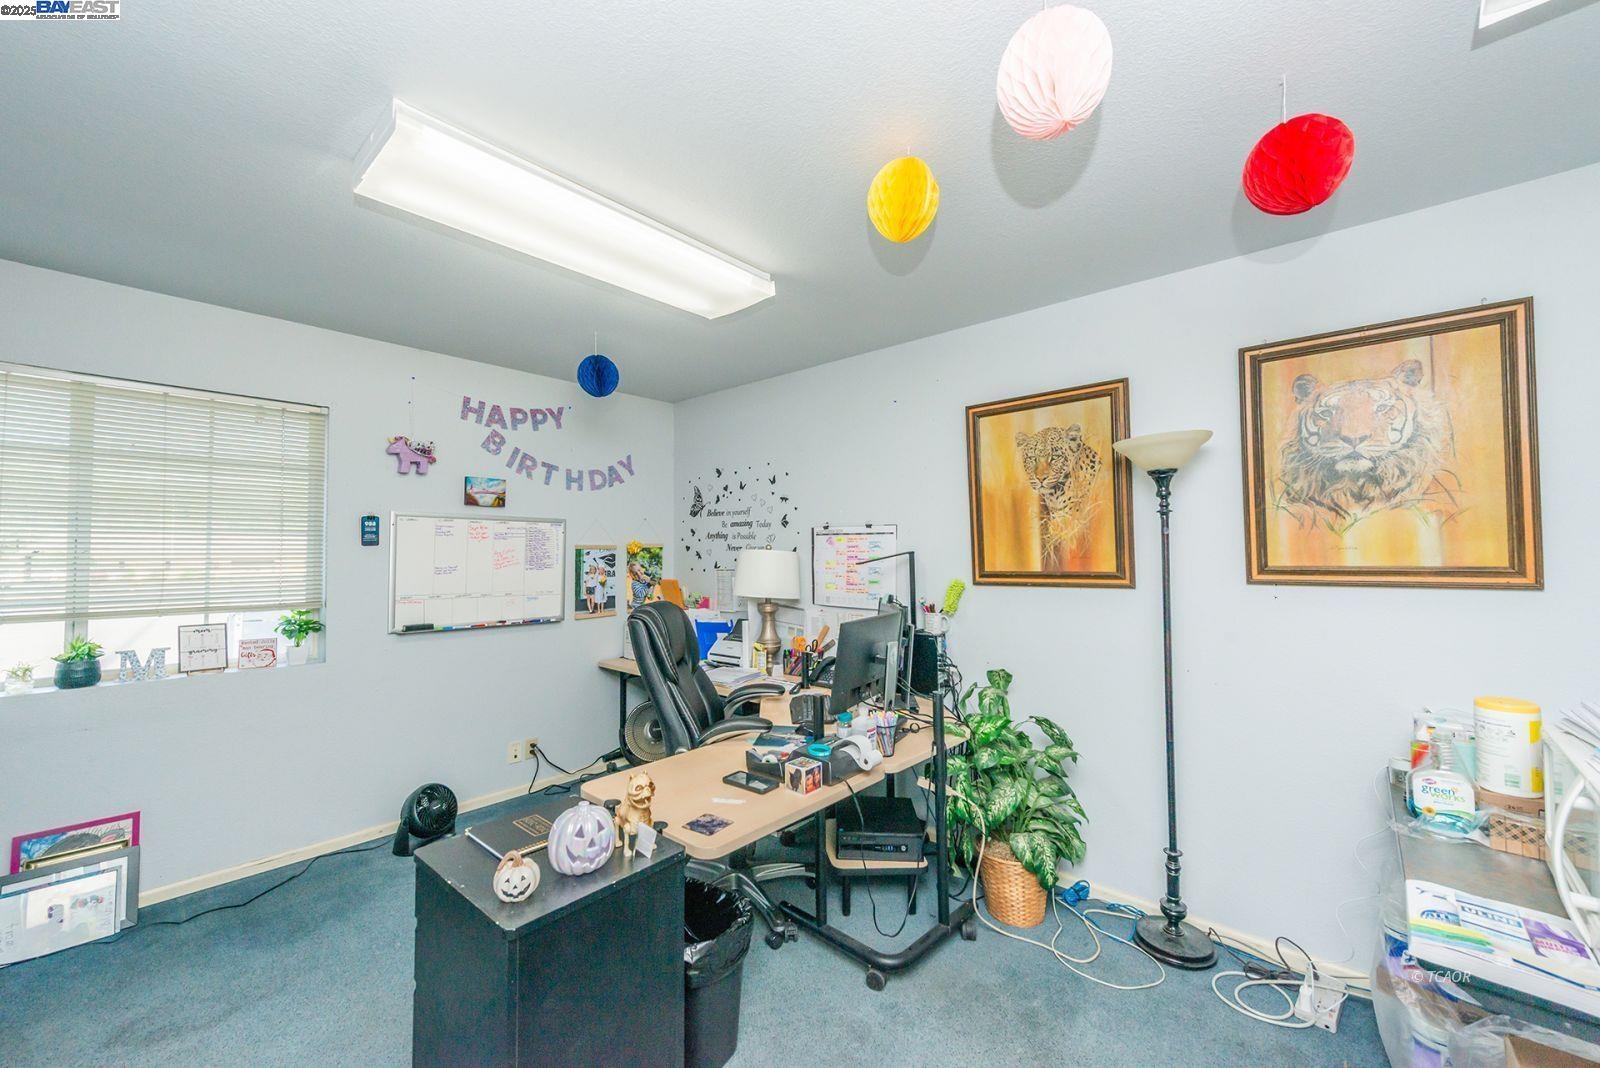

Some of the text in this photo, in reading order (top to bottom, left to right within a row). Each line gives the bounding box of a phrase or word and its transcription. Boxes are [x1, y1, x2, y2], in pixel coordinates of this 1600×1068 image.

[460, 395, 564, 432] HAPPY
[480, 429, 635, 491] BIRTHDAY
[707, 508, 726, 517] Believe
[730, 519, 753, 529] amazing
[705, 531, 729, 541] Anything
[726, 543, 743, 552] Never
[115, 647, 171, 683] M
[1421, 784, 1456, 796] green
